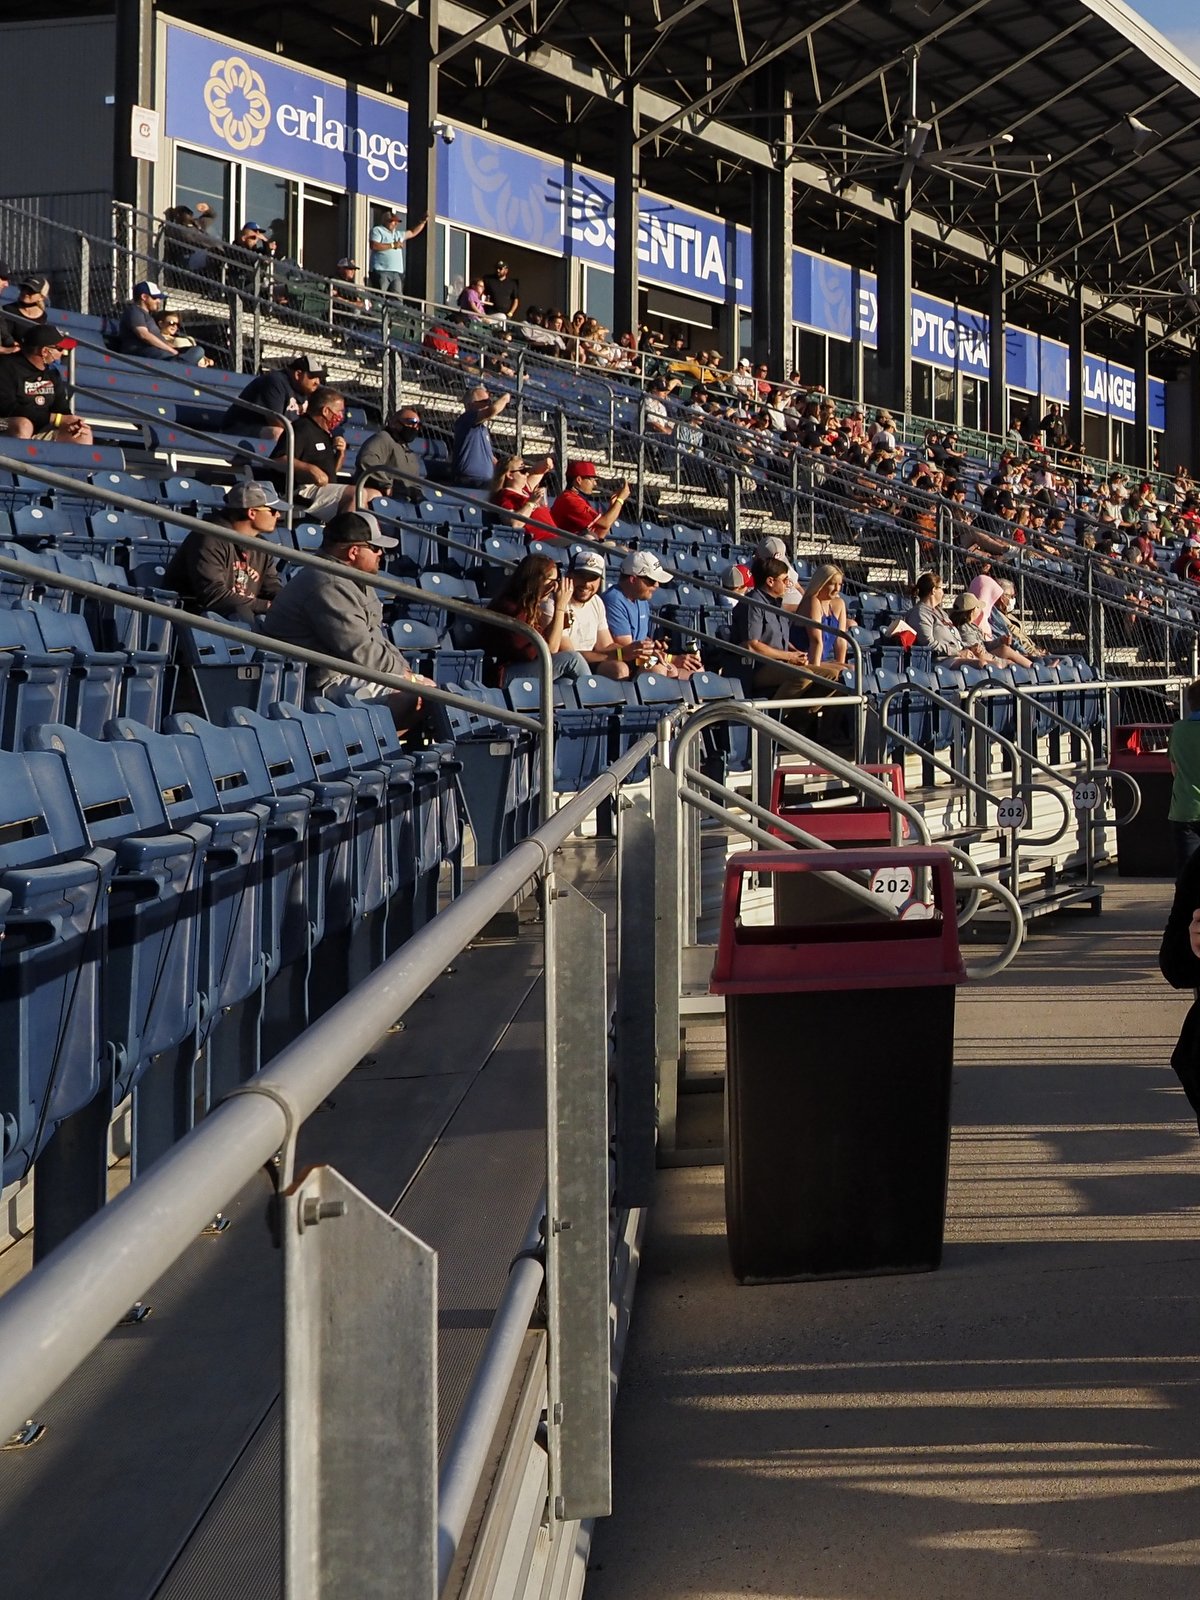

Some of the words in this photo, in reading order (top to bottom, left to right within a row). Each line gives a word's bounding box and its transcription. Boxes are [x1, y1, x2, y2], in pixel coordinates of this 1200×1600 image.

[276, 96, 408, 182] erlange
[245, 667, 253, 679] Q
[1074, 789, 1096, 801] 203
[998, 806, 1023, 819] 202
[875, 878, 911, 894] 202
